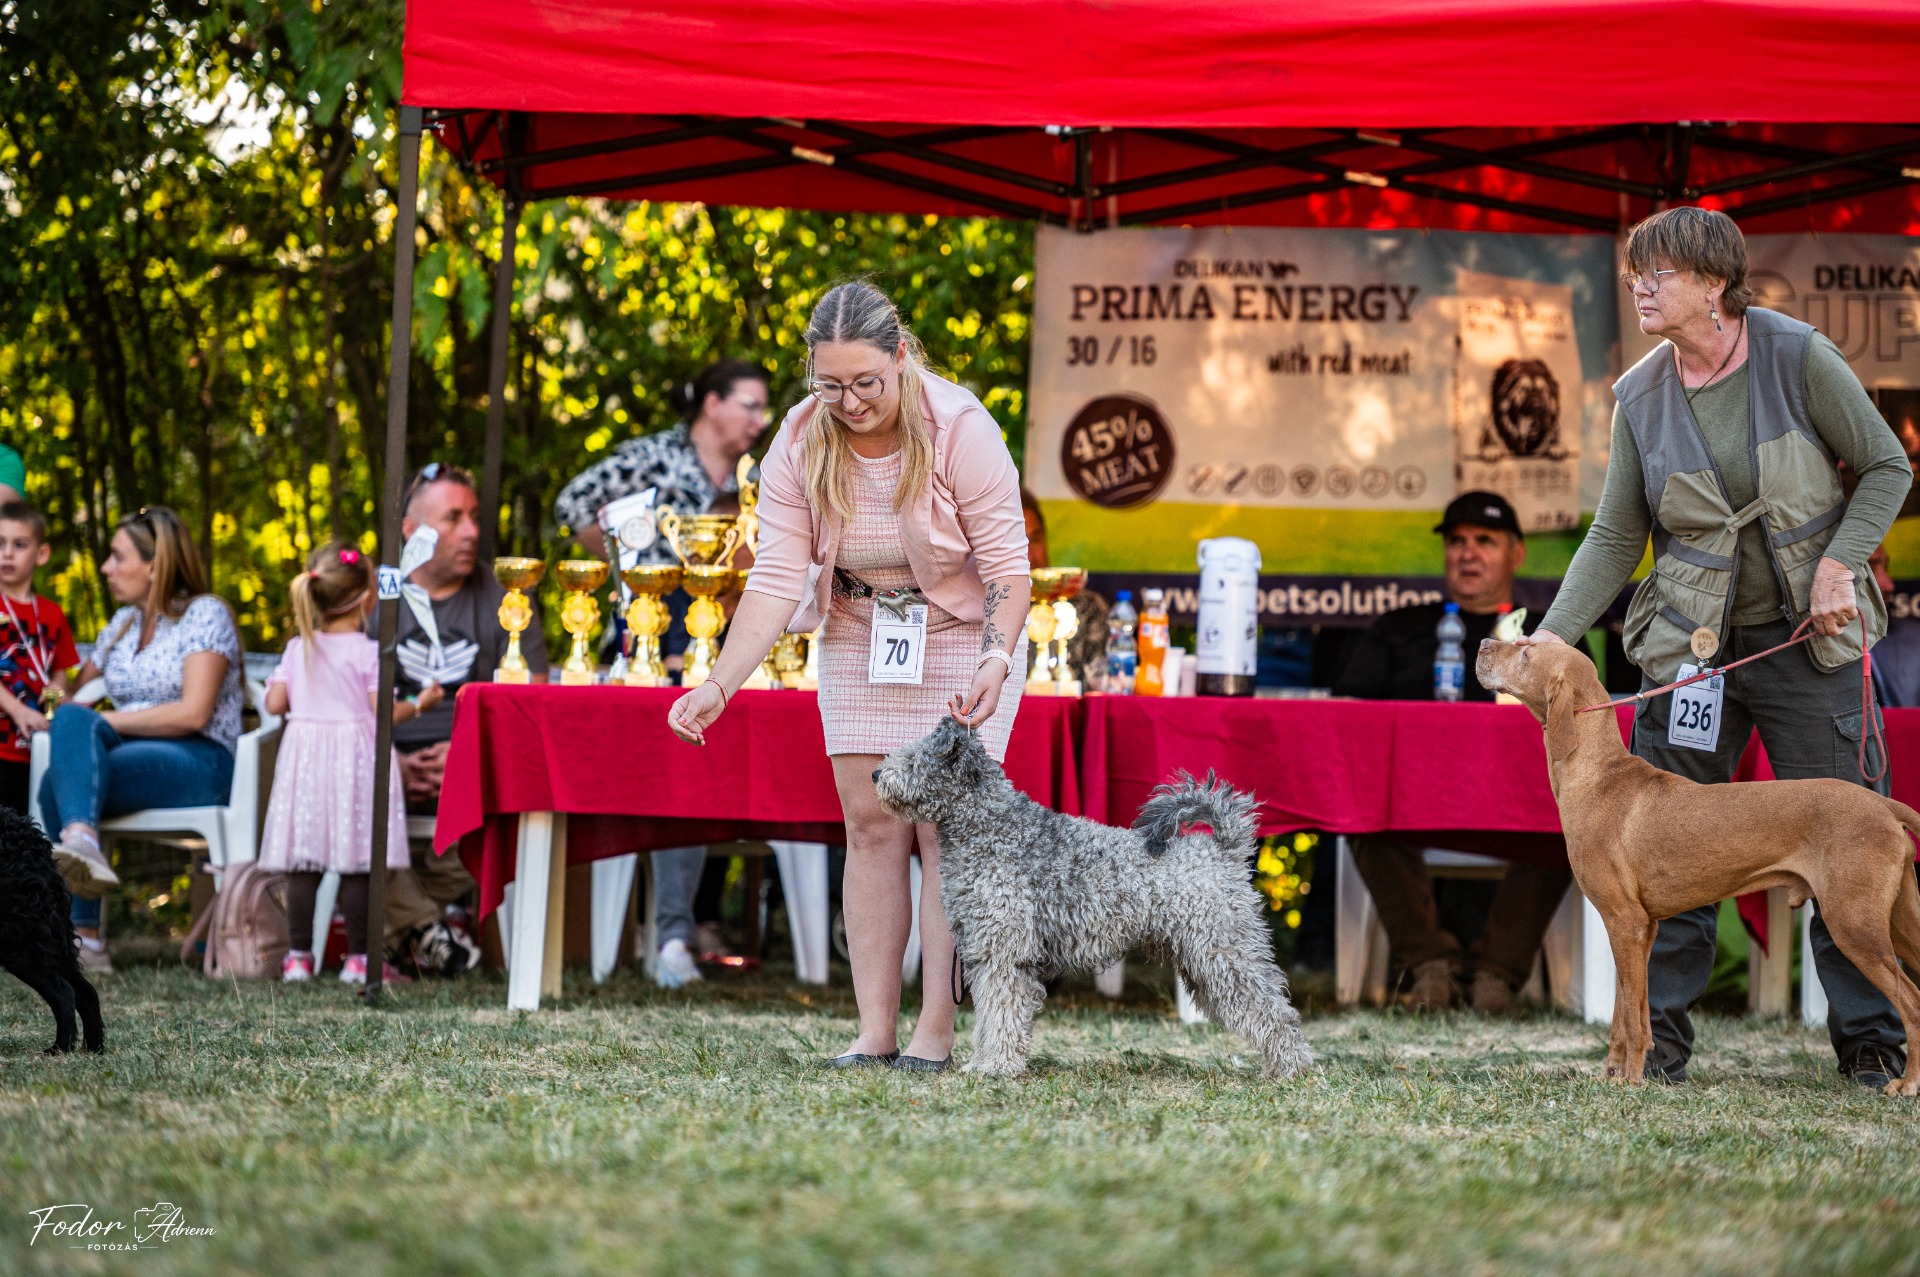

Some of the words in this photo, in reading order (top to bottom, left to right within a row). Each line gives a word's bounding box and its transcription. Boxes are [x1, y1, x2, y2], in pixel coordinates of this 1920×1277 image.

[1174, 260, 1263, 278] DELIKAN
[1071, 285, 1215, 321] PRIMA
[1232, 284, 1419, 322] ENERGY
[1067, 336, 1098, 366] 30
[1131, 335, 1157, 366] 16
[1268, 343, 1311, 374] with
[1318, 340, 1352, 375] red
[1359, 348, 1411, 375] meat
[1071, 408, 1153, 462] 45%
[1080, 443, 1160, 495] MEAT
[884, 638, 910, 666] 70
[1677, 698, 1713, 732] 236
